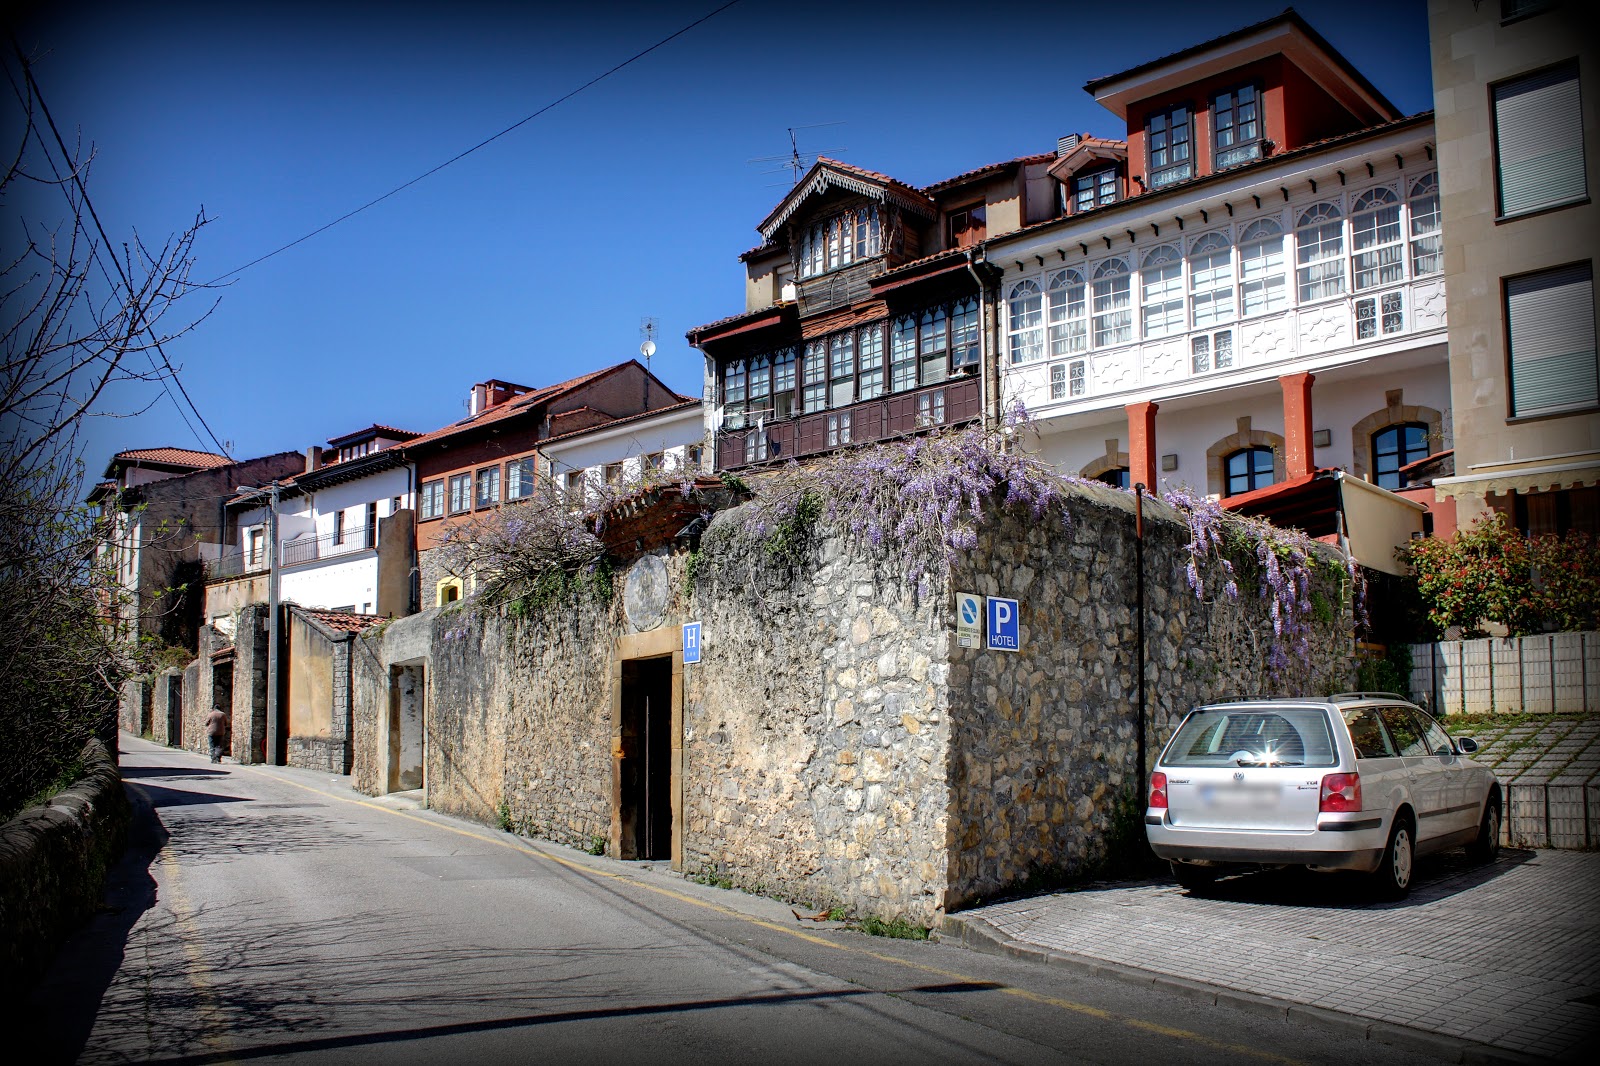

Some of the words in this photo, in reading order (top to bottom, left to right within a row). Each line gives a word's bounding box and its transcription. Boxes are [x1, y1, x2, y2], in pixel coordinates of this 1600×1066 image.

[995, 601, 1011, 634] P
[686, 627, 697, 649] H
[991, 634, 1016, 647] HOTEL
